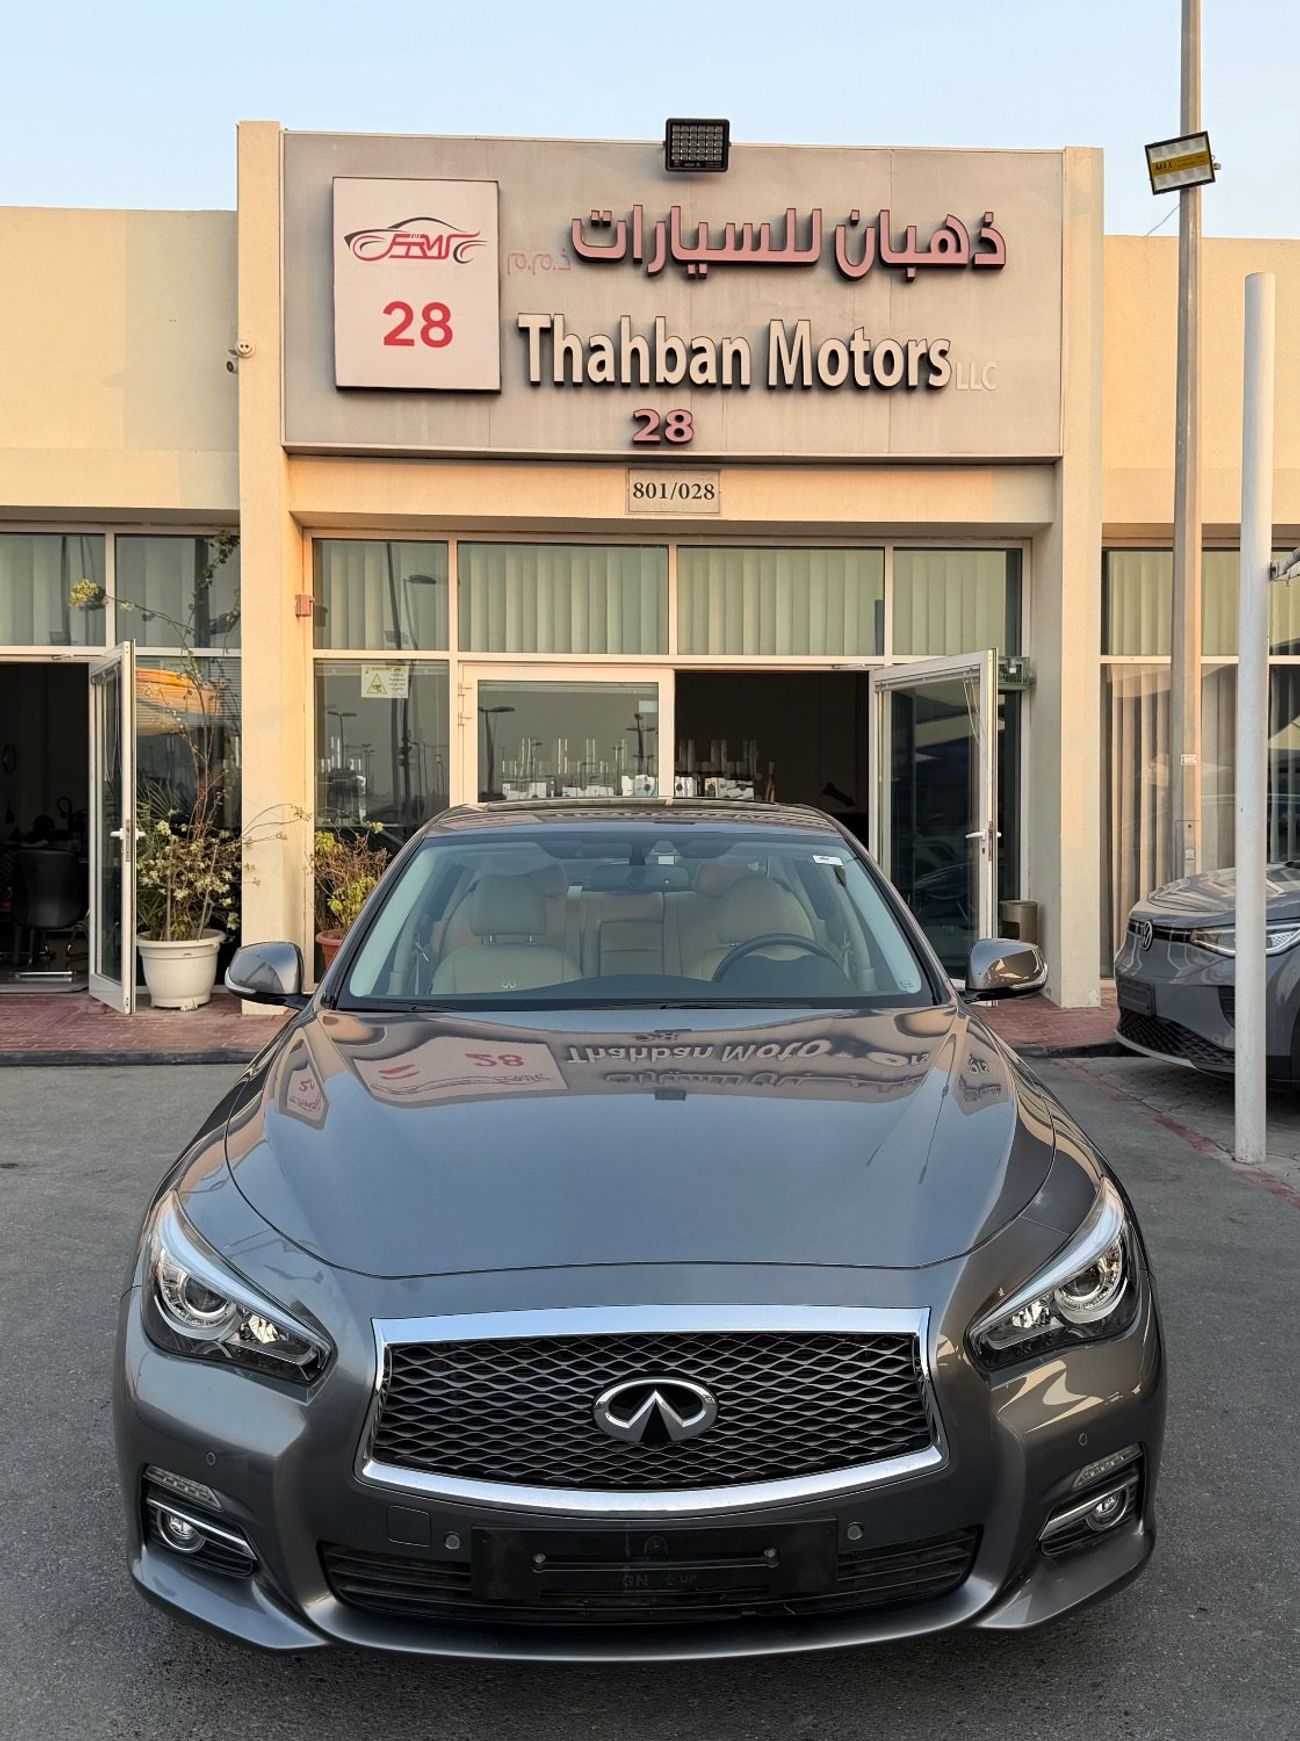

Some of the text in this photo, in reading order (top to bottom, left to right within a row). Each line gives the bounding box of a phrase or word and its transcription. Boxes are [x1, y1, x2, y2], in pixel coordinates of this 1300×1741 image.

[571, 204, 822, 279] للسيارات
[835, 208, 1006, 282] ذهبان
[383, 300, 454, 349] 28
[517, 312, 998, 391] Thahban Motors LLC
[632, 408, 695, 445] 28
[632, 481, 716, 502] 801/028
